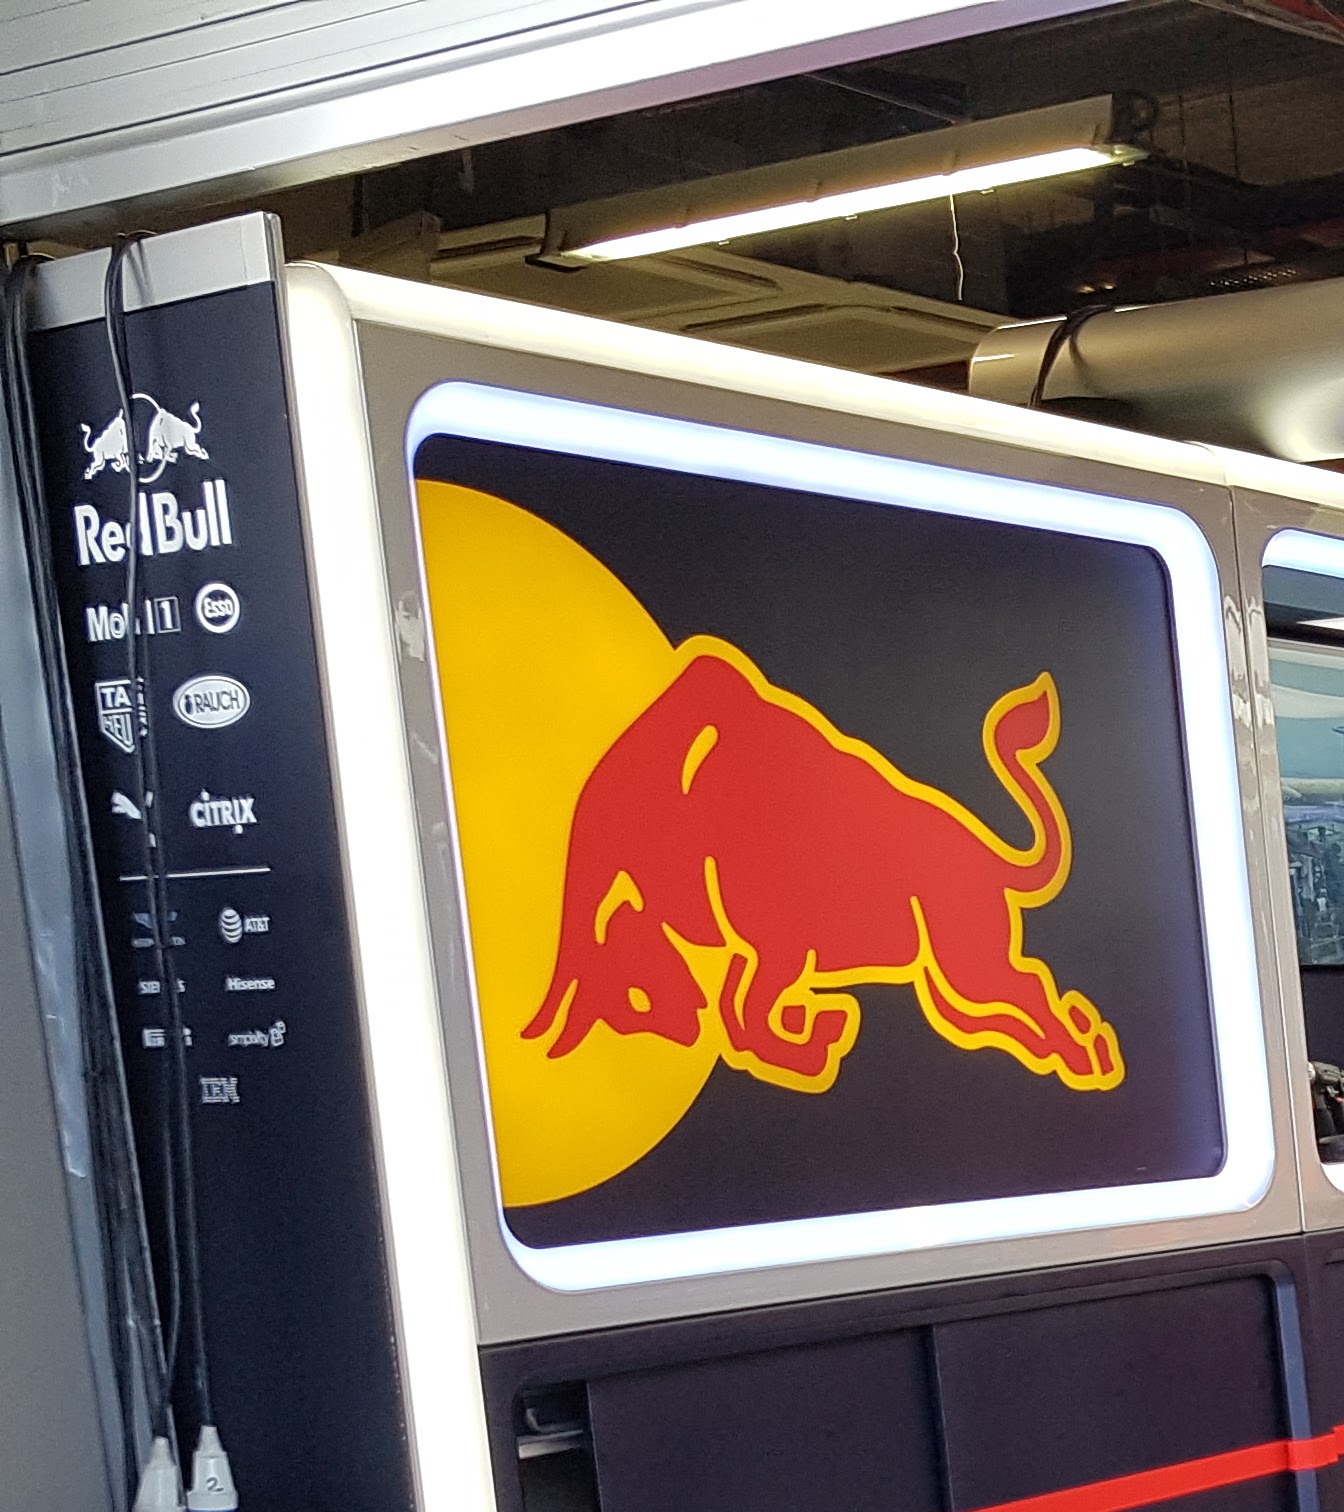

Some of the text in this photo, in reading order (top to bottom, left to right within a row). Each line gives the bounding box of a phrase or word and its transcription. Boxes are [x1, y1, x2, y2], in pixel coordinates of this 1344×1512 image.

[195, 690, 240, 714] RAUCH
[244, 917, 271, 932] AT&T
[225, 977, 275, 991] Hisense
